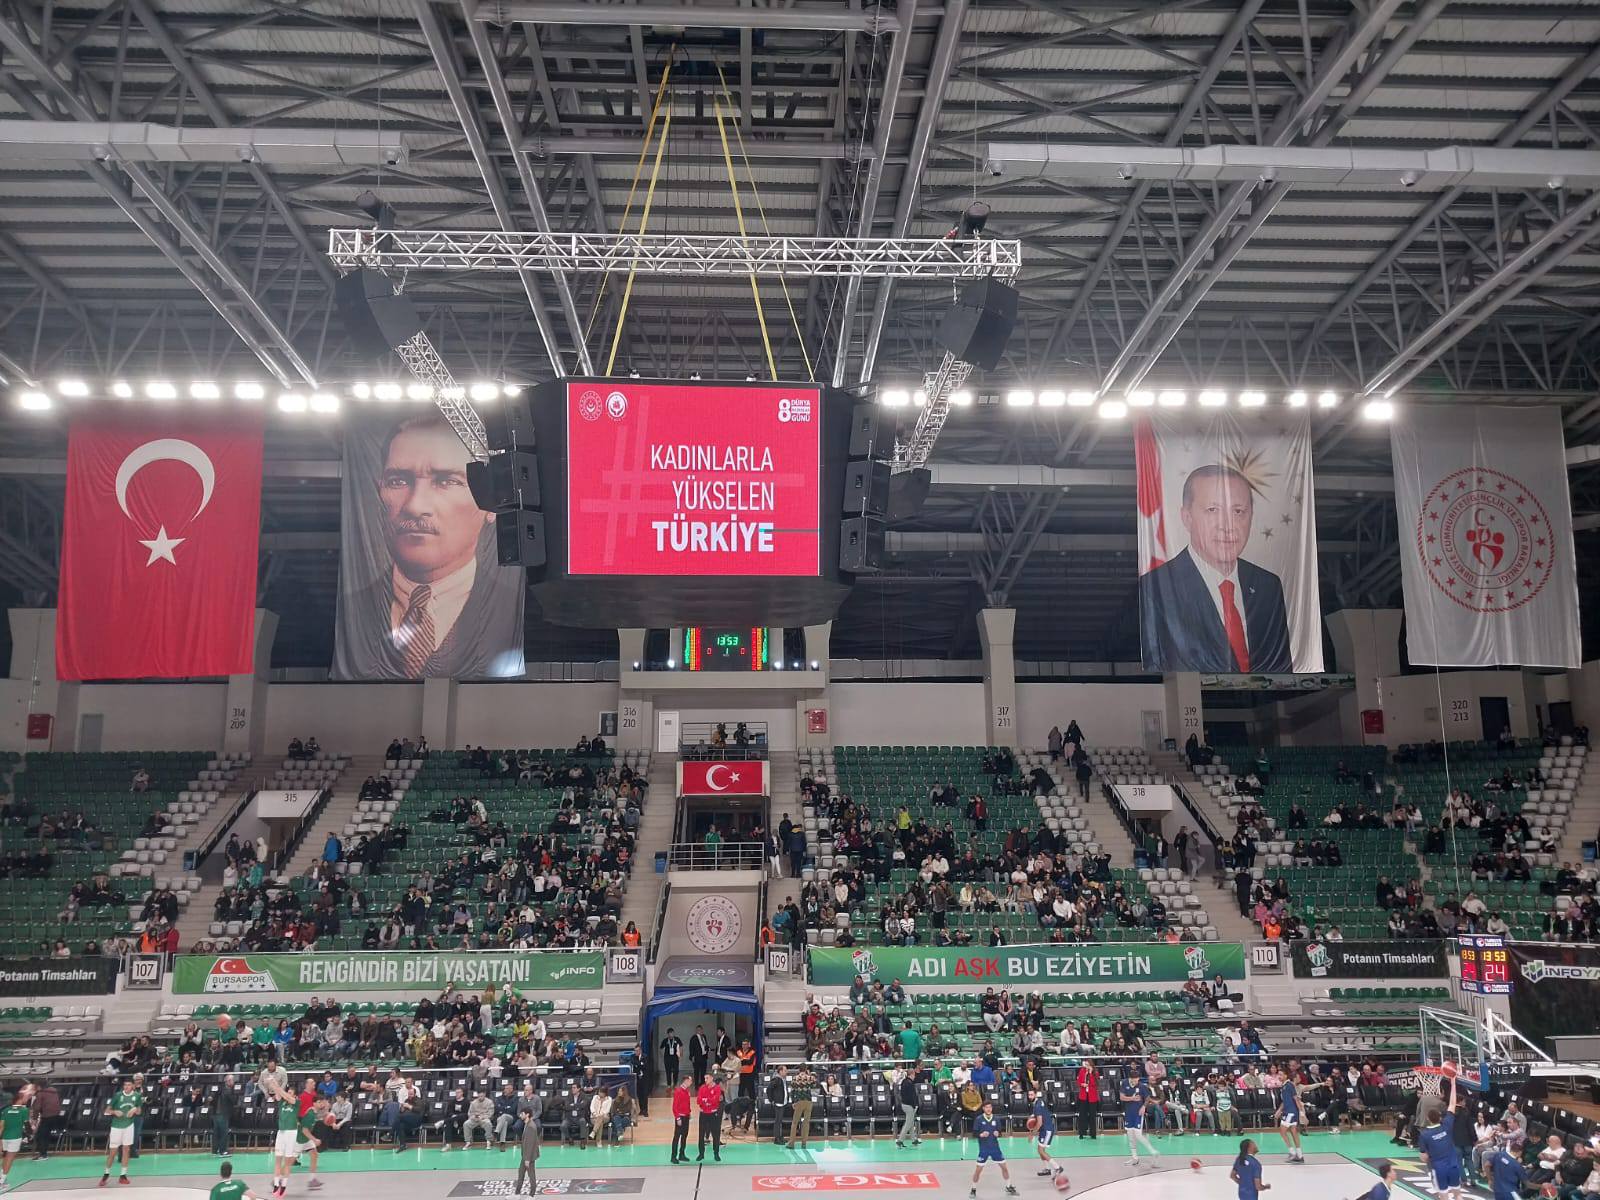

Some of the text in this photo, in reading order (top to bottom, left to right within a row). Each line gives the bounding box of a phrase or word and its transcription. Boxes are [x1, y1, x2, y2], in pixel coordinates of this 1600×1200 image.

[778, 399, 791, 422] 8
[651, 445, 774, 472] KADINLARLA
[672, 475, 774, 510] YÜKSELEN
[651, 514, 774, 552] TÜRKİYE
[623, 706, 637, 716] 316
[997, 706, 1009, 716] 317
[1184, 706, 1197, 716] 319
[1452, 700, 1468, 710] 320
[232, 708, 246, 718] 314
[1453, 712, 1469, 721] 213
[230, 719, 246, 729] 209
[623, 718, 636, 728] 210
[997, 717, 1010, 727] 211
[1184, 718, 1199, 728] 212
[284, 793, 297, 803] 315
[1132, 787, 1146, 797] 318
[771, 954, 787, 969] 109
[1256, 949, 1273, 962] 110
[1343, 952, 1435, 964] Potanın Timsahları
[616, 956, 635, 971] 108
[908, 952, 1151, 981] ADI AŞK BU EZİYETİN
[41, 969, 97, 981] Timsahları
[135, 963, 154, 977] 107
[300, 956, 531, 986] RENGİNDİR BİZİ YAŞATAN!
[1485, 964, 1505, 982] 24
[212, 975, 266, 985] BURSASPOR
[832, 1173, 935, 1187] ING
